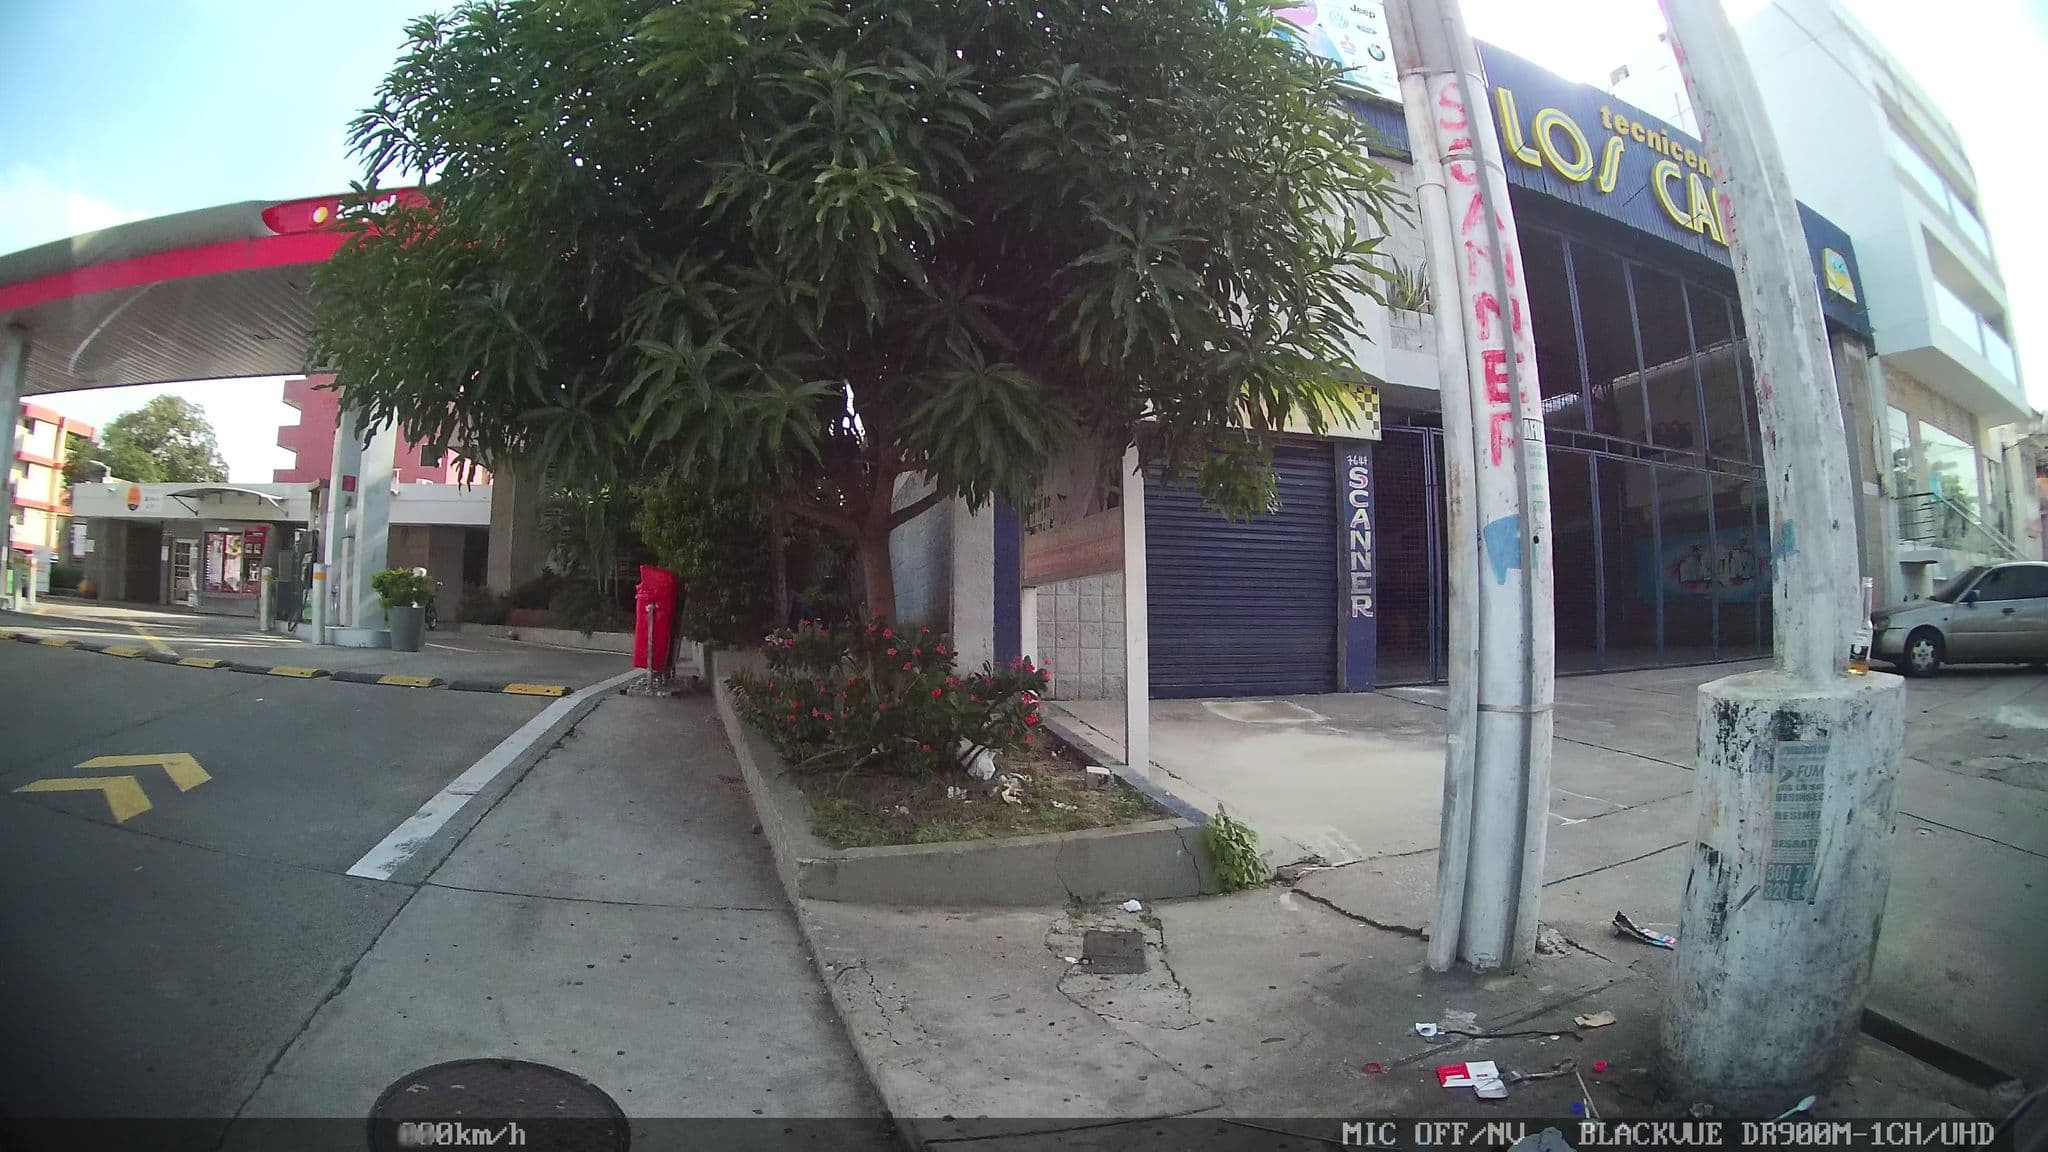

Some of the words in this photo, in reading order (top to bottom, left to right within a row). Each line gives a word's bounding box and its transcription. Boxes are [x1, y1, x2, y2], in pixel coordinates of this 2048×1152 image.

[1350, 4, 1376, 19] Jeep
[1494, 86, 1625, 193] LOS
[1349, 467, 1374, 618] SCANNER
